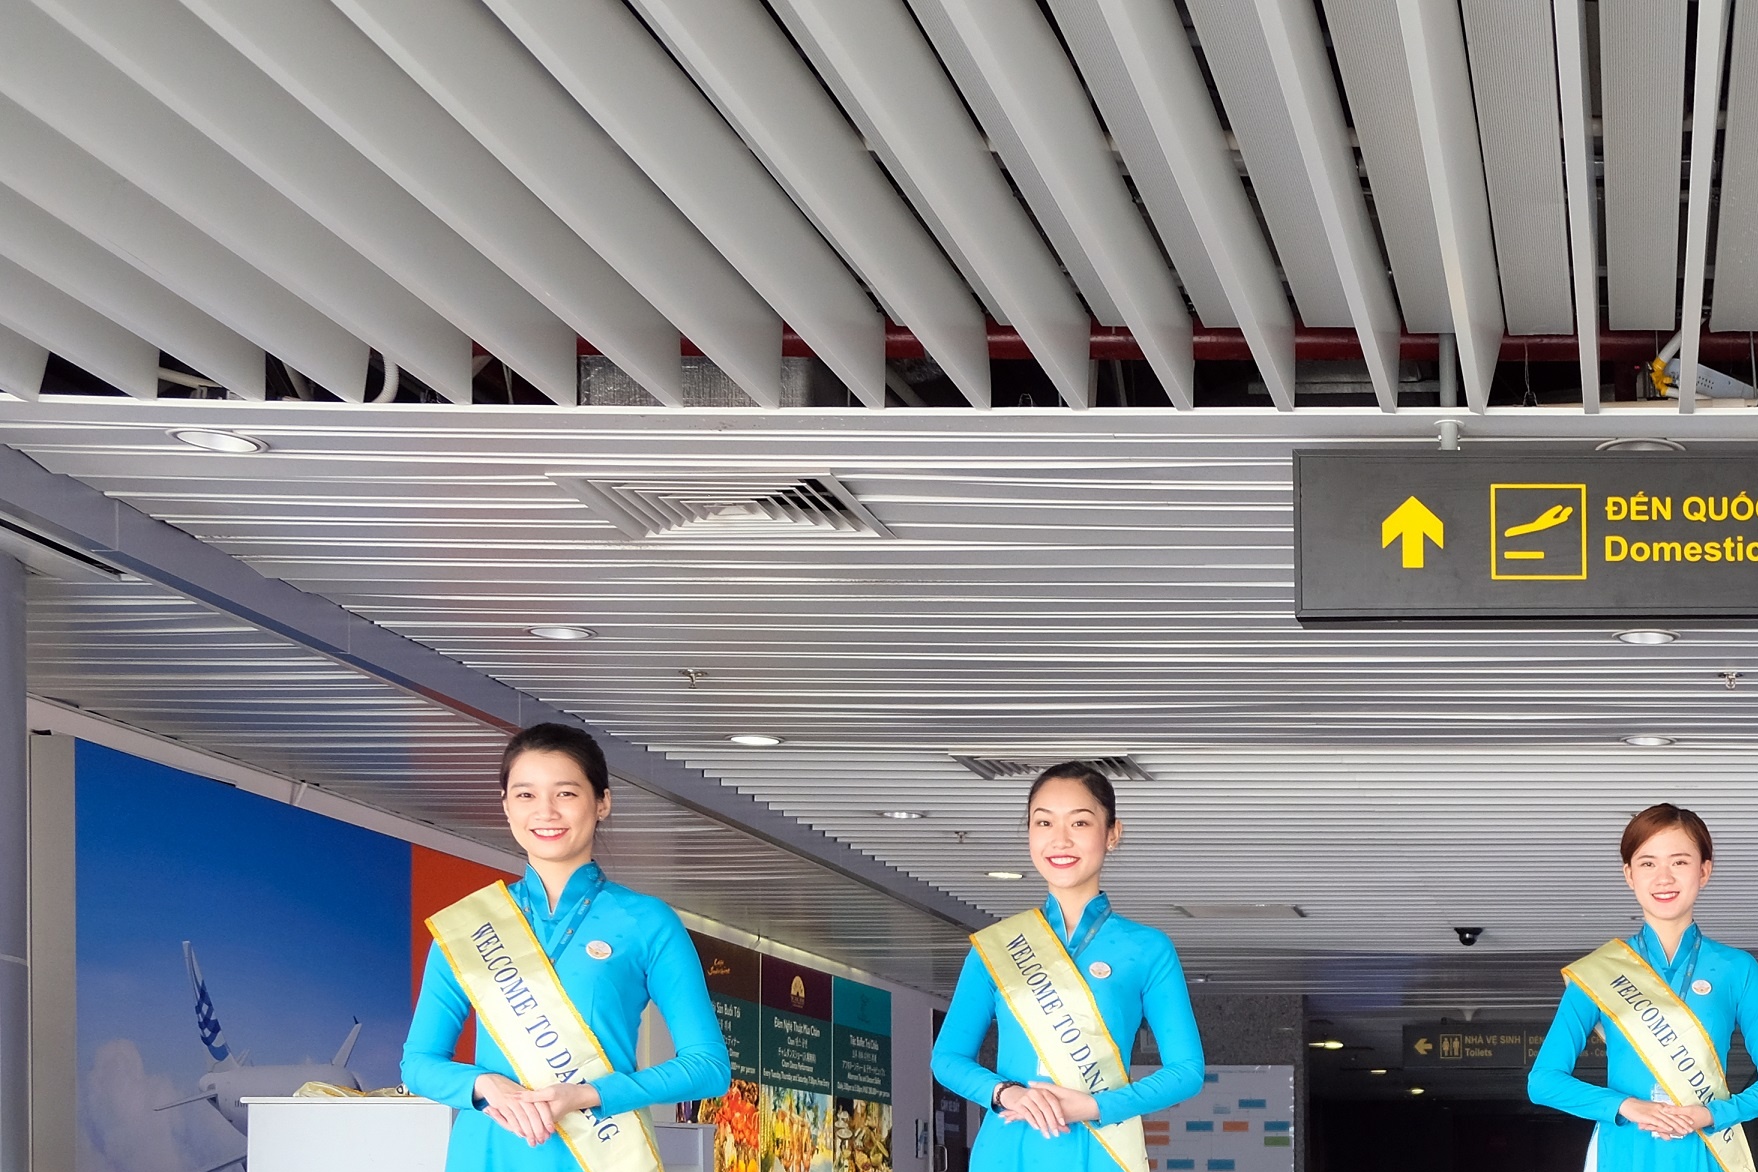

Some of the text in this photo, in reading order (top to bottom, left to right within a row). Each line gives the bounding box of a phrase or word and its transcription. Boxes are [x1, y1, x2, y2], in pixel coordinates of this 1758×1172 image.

[1605, 491, 1672, 521] ĐẾN
[471, 921, 539, 1017] WELCOME
[524, 1013, 559, 1050] TO
[1004, 933, 1063, 1017] WELCOME
[1052, 1012, 1084, 1046] TO
[1465, 1033, 1521, 1046] NHÀ VỆ SINH
[1465, 1047, 1493, 1057] Toilets
[1609, 973, 1679, 1049] WELCOME
[1669, 1043, 1698, 1074] TO
